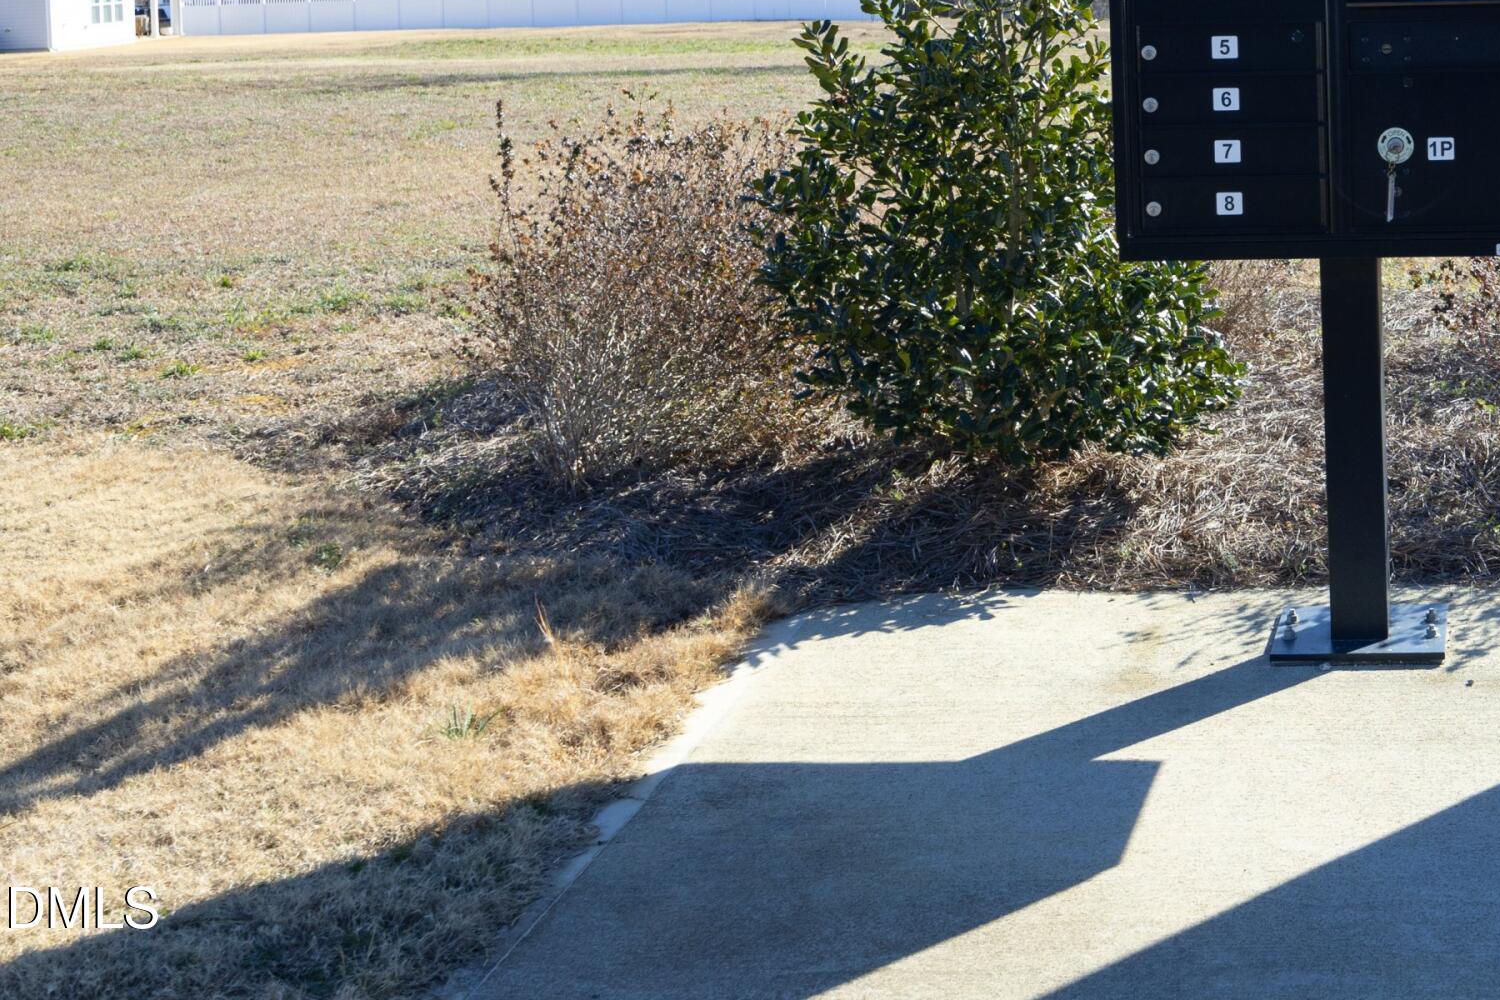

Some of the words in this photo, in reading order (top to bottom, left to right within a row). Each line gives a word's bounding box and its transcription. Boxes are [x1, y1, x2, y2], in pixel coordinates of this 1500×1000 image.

[1218, 39, 1232, 56] 5
[1219, 91, 1233, 108] 6
[1221, 143, 1234, 160] 7
[1429, 140, 1453, 157] 1P
[1223, 195, 1236, 212] 8
